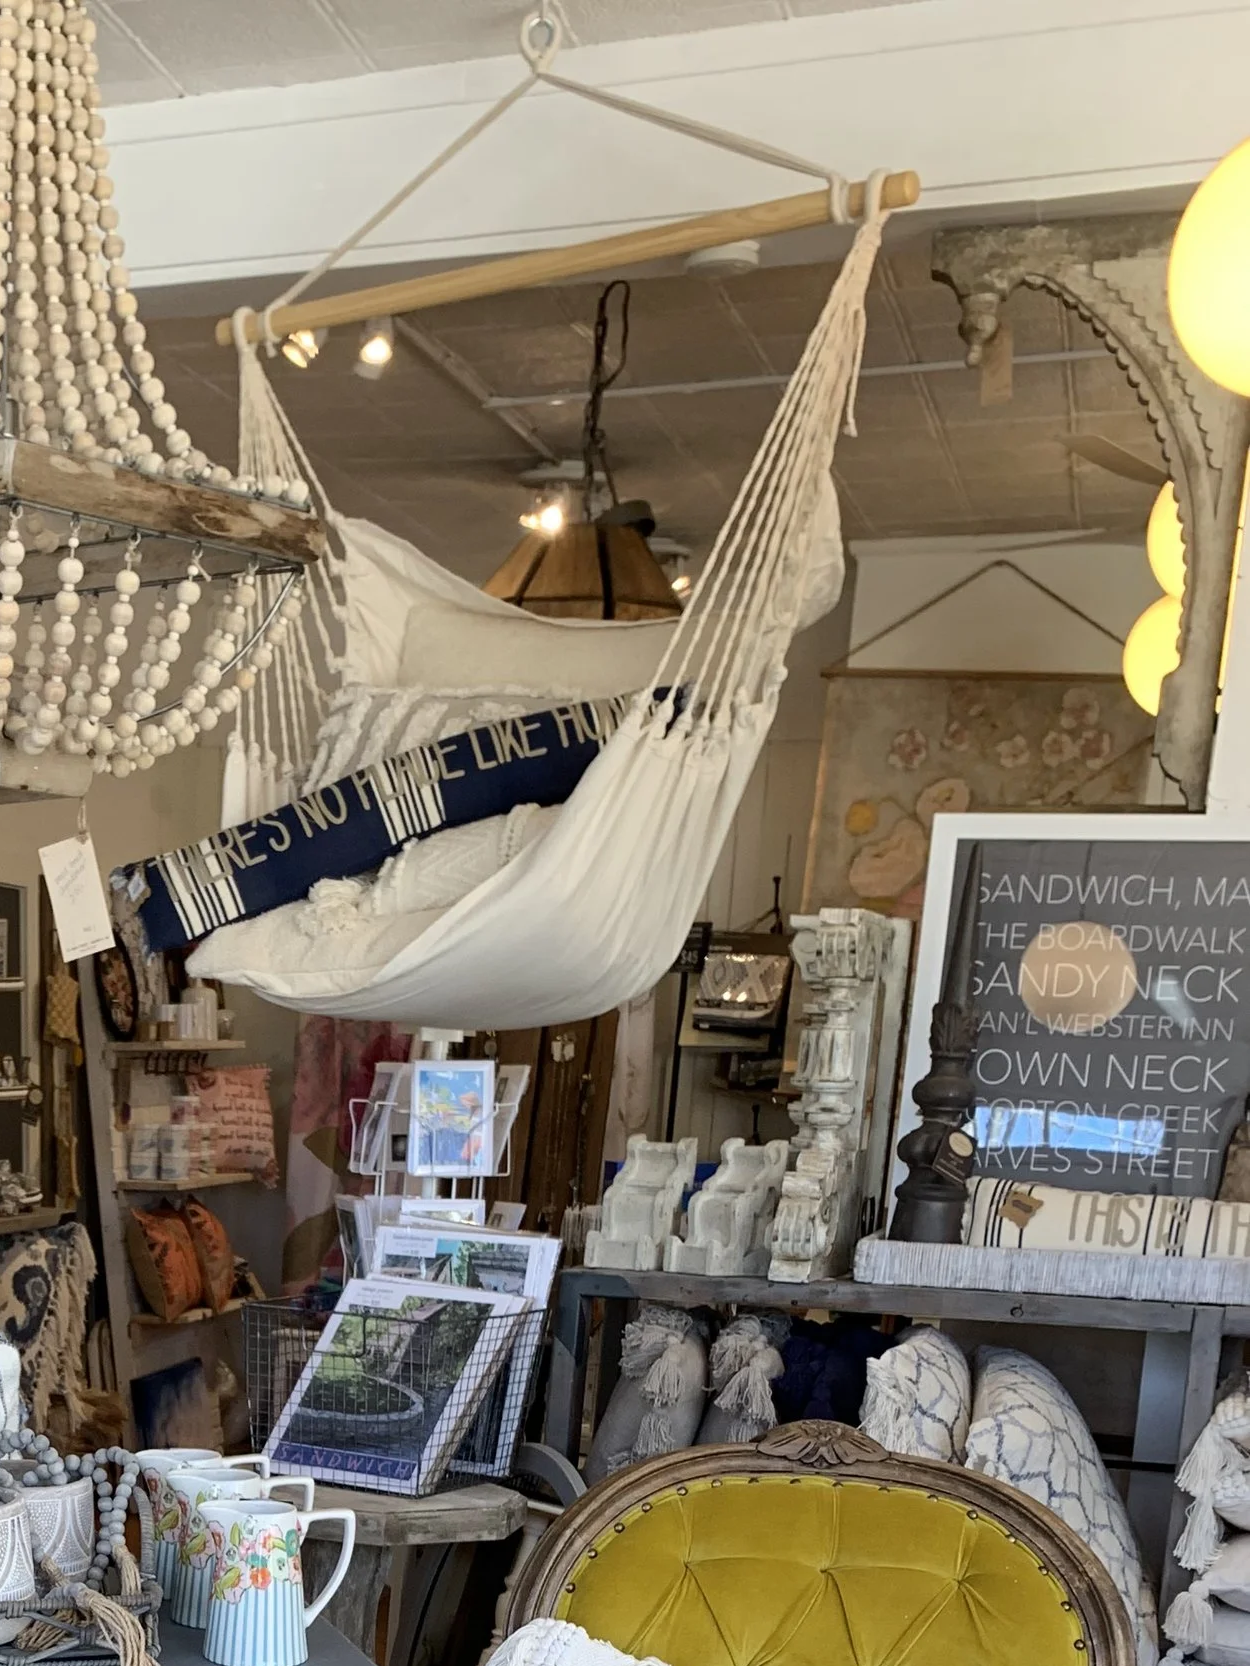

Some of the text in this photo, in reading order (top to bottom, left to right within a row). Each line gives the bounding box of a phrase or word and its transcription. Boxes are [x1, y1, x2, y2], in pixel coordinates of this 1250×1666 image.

[293, 784, 347, 838] NO
[467, 717, 548, 770] LIKE
[1193, 876, 1250, 907] MA
[978, 922, 1247, 954] HE BOARDWALK
[1119, 964, 1243, 1004] NECK
[977, 1010, 1234, 1042] AN'L WEBSTER INN
[971, 1048, 1229, 1093] OWN NECK
[1117, 1103, 1222, 1133] CREEK
[1084, 1145, 1220, 1179] STREET
[1069, 1192, 1144, 1248] THIS
[1155, 1196, 1191, 1250] IS
[278, 1444, 410, 1478] SANDWICH
